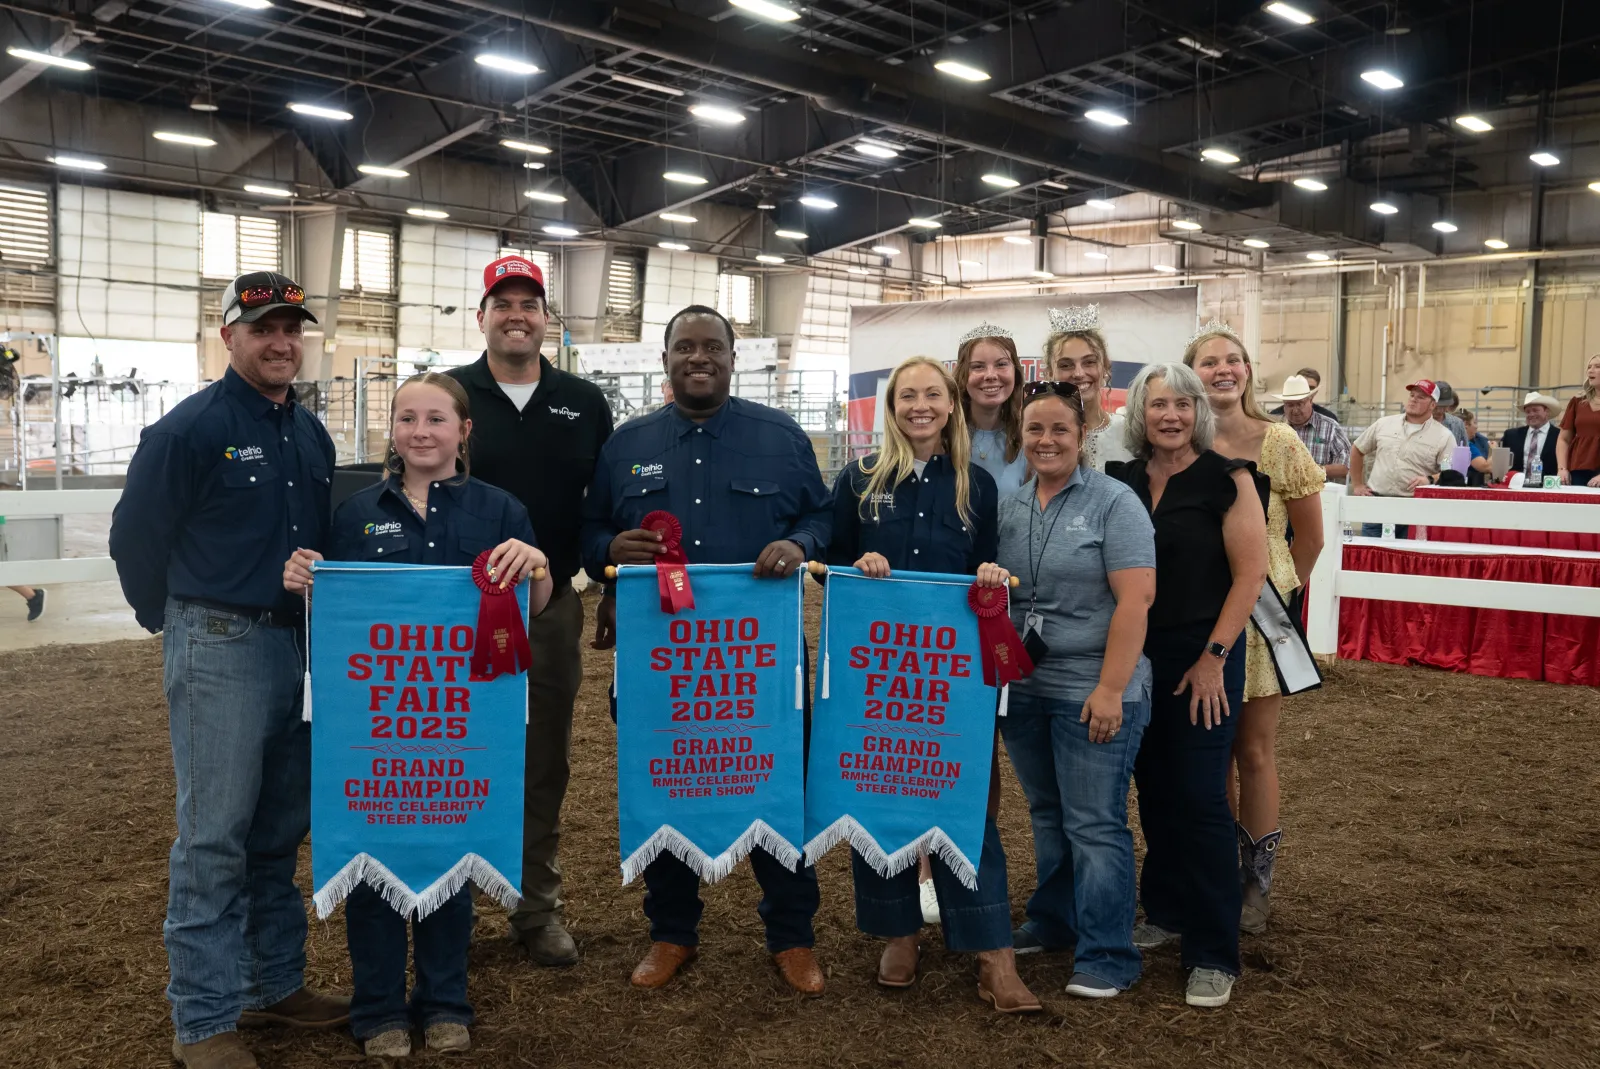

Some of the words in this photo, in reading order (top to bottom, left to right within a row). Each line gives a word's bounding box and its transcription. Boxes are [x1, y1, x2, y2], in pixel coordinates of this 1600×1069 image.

[238, 445, 263, 457] telhio
[641, 462, 664, 473] telhio
[375, 521, 402, 532] telhio
[369, 623, 475, 652] OHIO
[669, 617, 760, 644] OHIO
[869, 620, 957, 651] OHIO
[650, 643, 777, 672] STATE
[849, 645, 972, 678] STATE
[669, 671, 758, 699] FAIR
[864, 673, 951, 703] FAIR
[368, 685, 472, 713] FAIR
[671, 698, 755, 722] 2025
[864, 699, 946, 726] 2025
[370, 715, 468, 740] 2025
[672, 735, 753, 757] GRAND
[863, 735, 942, 758] GRAND
[371, 757, 466, 778] GRAND
[649, 752, 775, 776] CHAMPION
[839, 752, 962, 779] CHAMPION
[344, 778, 491, 799] CHAMPION
[652, 776, 691, 788] RMHC
[696, 772, 771, 787] CELEBRITY
[841, 770, 879, 783] RMHC
[883, 774, 957, 790] CELEBRITY
[855, 783, 896, 795] STEER
[901, 786, 941, 800] SHOW
[669, 787, 713, 799] STEER
[716, 785, 756, 797] SHOW
[348, 800, 394, 813] RMHC
[398, 799, 486, 812] CELEBRITY
[366, 813, 417, 825] STEER
[421, 813, 469, 825] SHOW
